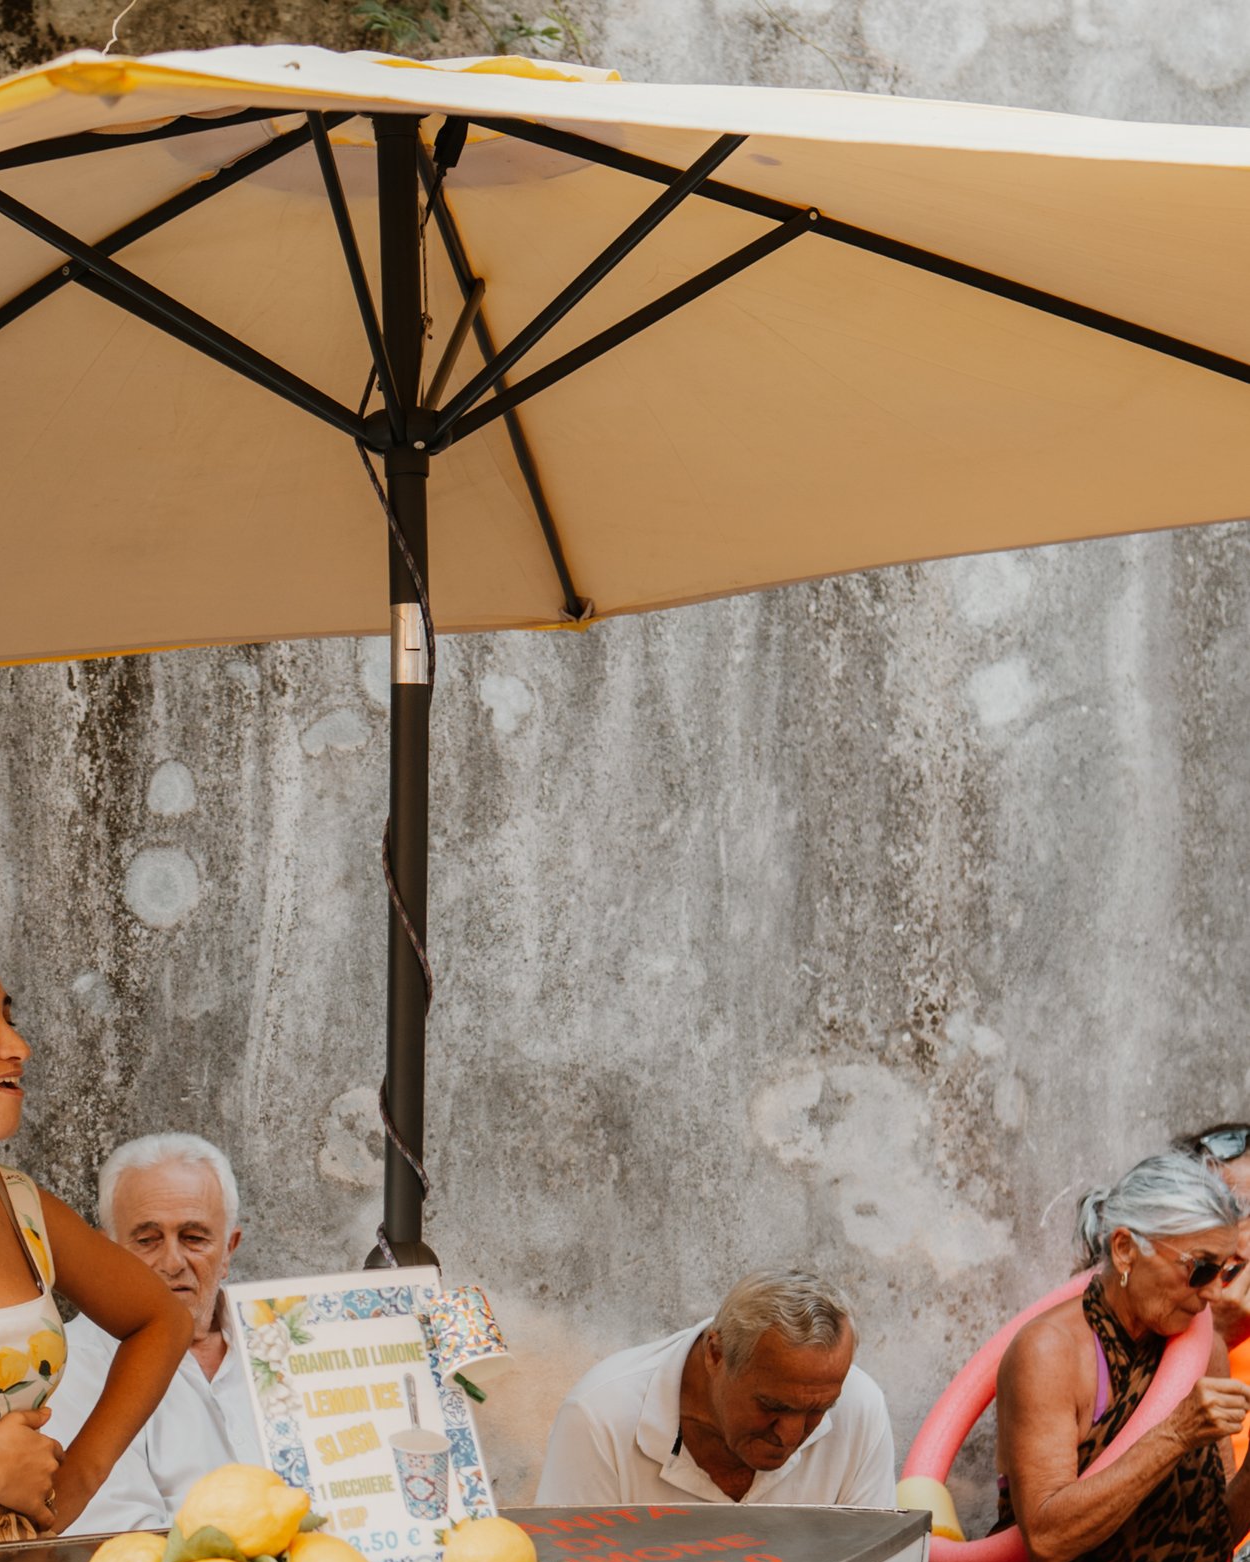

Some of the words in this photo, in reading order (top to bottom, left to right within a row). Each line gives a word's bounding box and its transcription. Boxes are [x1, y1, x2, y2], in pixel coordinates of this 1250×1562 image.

[288, 1348, 352, 1376] GRANITA
[353, 1347, 370, 1368] DI
[370, 1341, 426, 1366] LIMONE
[303, 1384, 371, 1419] LEMON
[370, 1381, 404, 1410] ICE
[314, 1421, 382, 1466] SLUSH
[318, 1484, 327, 1501] 1
[329, 1474, 396, 1500] BICCHIERE
[337, 1506, 369, 1530] CUP
[407, 1527, 421, 1546] €
[551, 1534, 621, 1553] DI
